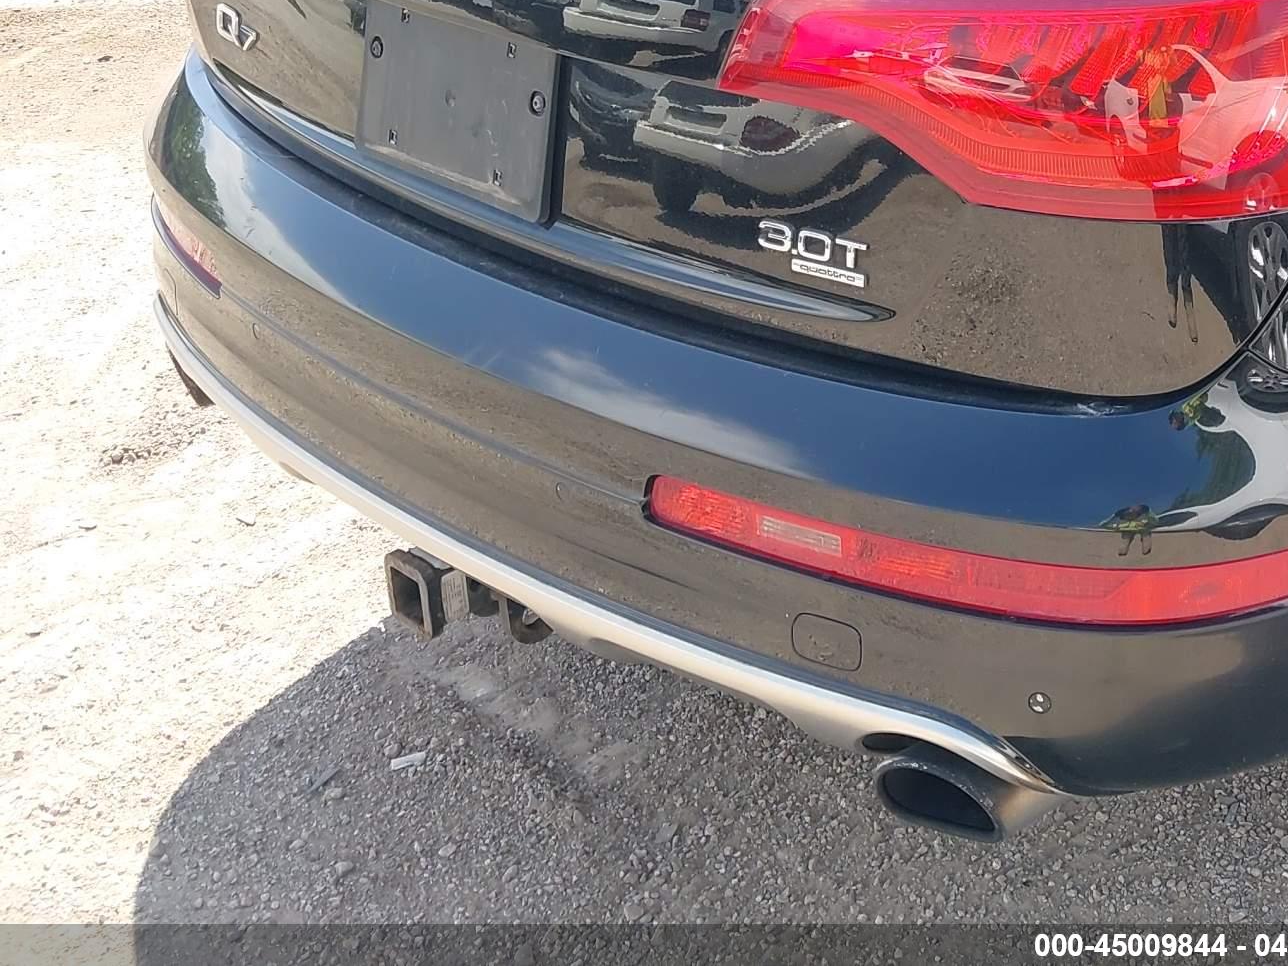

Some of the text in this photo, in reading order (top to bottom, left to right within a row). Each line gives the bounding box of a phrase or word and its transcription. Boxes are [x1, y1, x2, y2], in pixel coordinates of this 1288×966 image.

[216, 3, 258, 50] Q7
[758, 220, 868, 269] 3.0T
[799, 263, 856, 283] quattro
